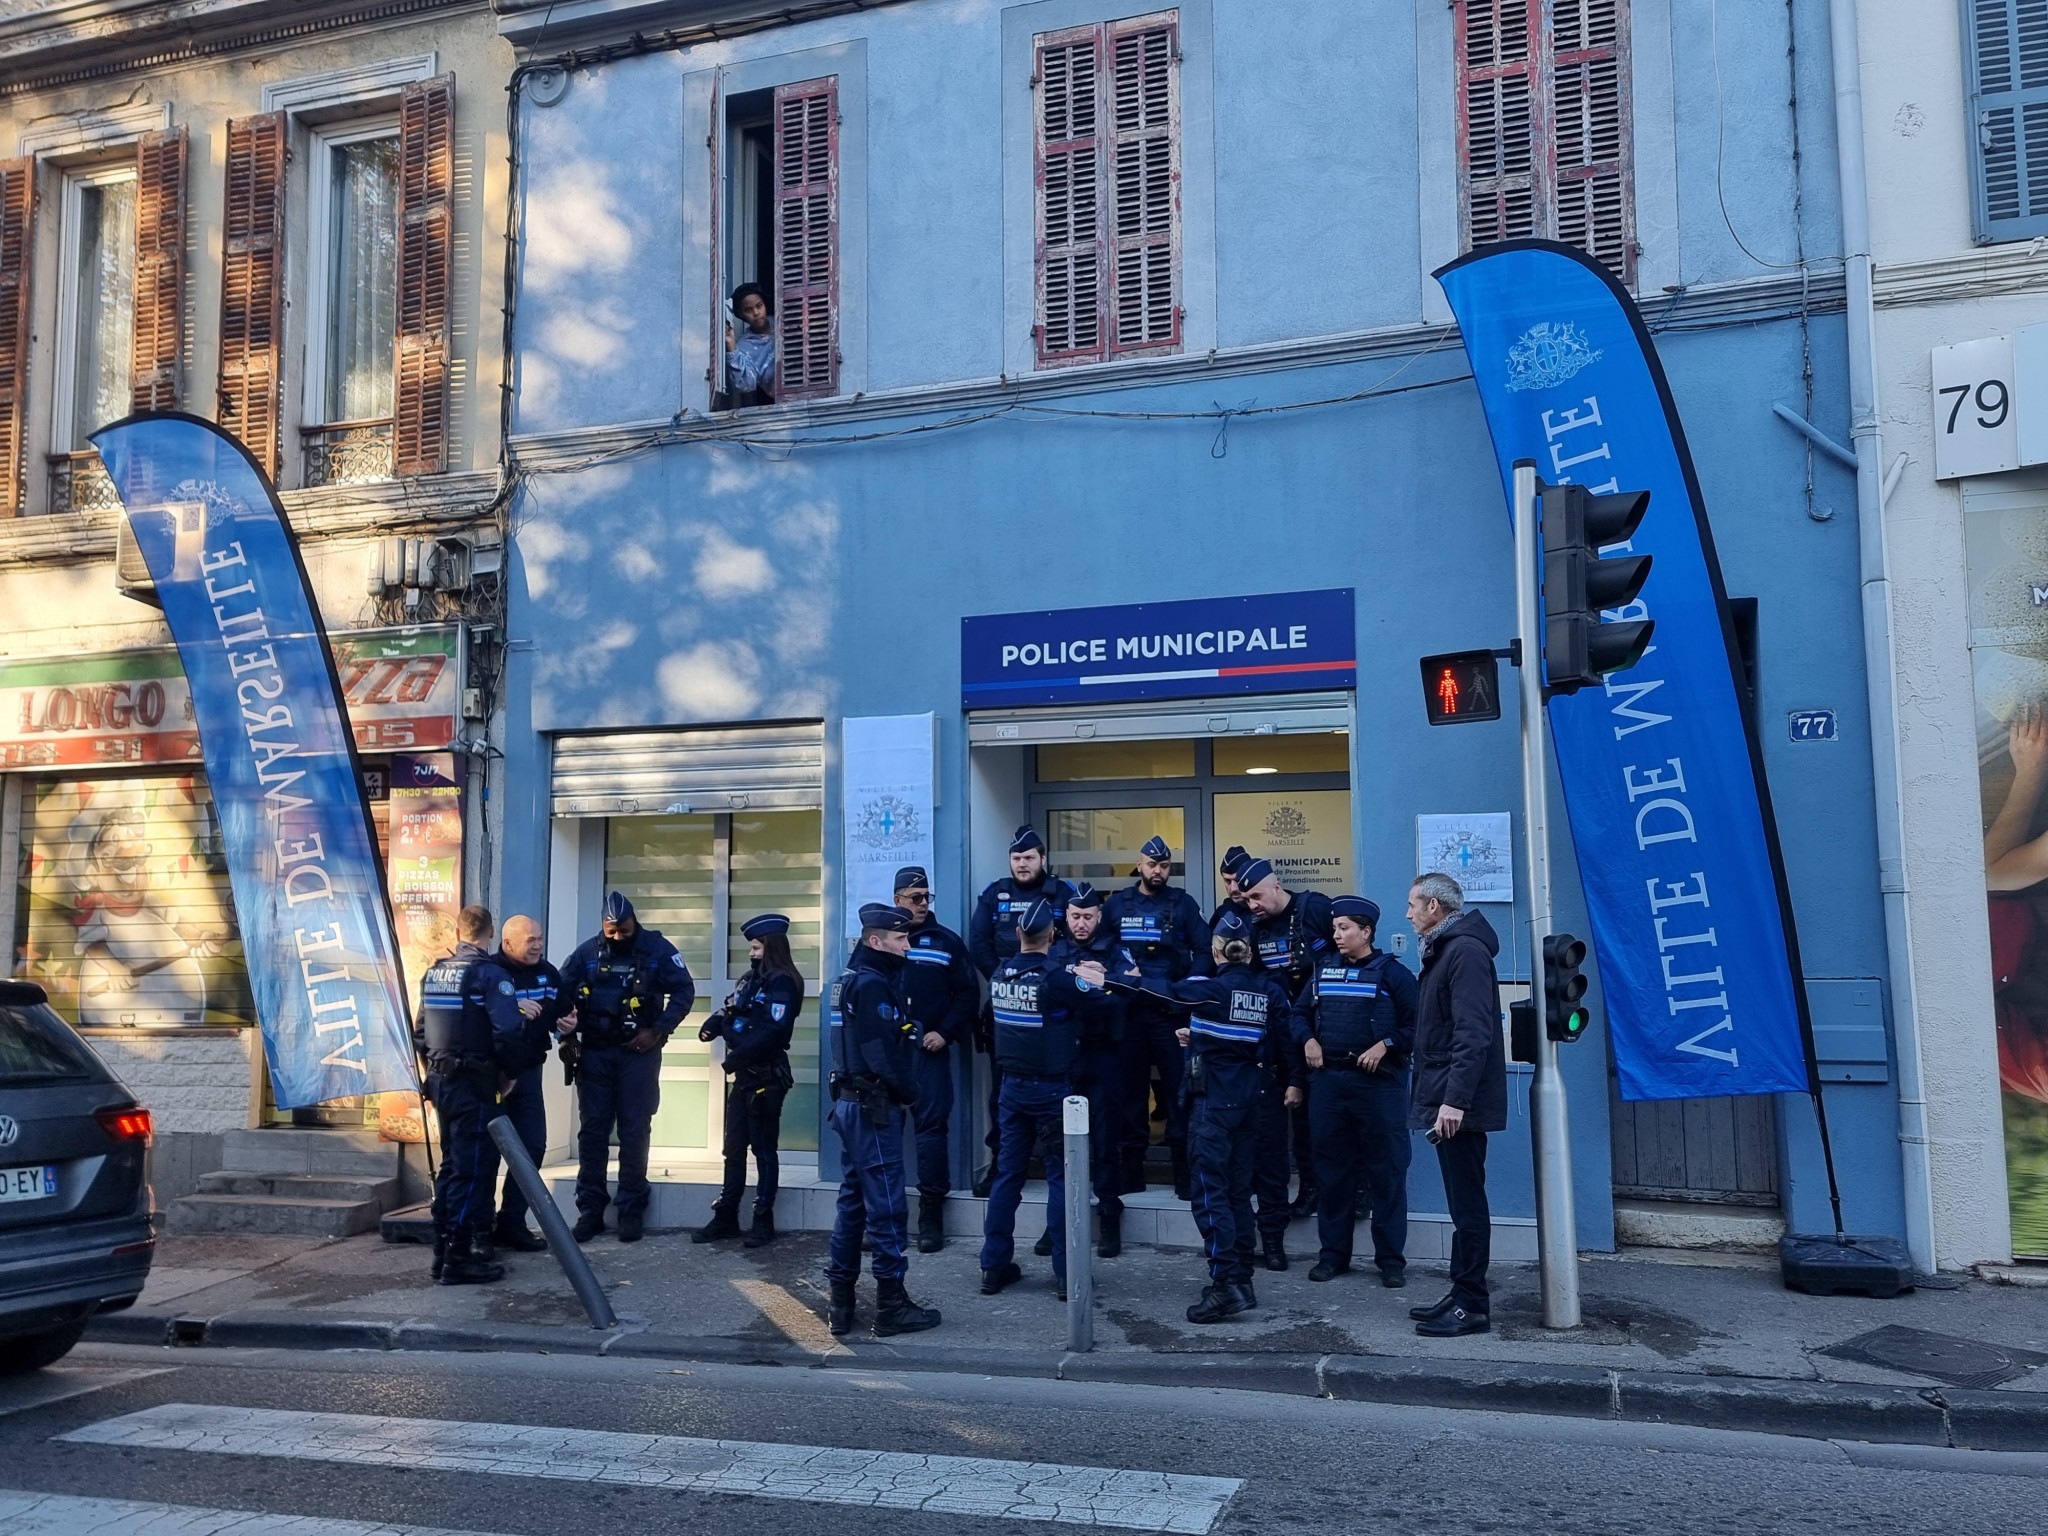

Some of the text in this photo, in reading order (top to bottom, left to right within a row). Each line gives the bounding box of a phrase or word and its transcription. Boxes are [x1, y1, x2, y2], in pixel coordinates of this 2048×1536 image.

[1938, 380, 2009, 434] 79
[1002, 625, 1308, 667] POLICE MUNICIPALE
[18, 681, 166, 734] LONGO
[1797, 717, 1827, 736] 77
[414, 765, 439, 776] 7J/7
[392, 788, 420, 798] 17H30
[432, 787, 461, 797] 22H00
[402, 813, 443, 824] PORTION
[418, 856, 429, 868] 3
[859, 851, 918, 863] MARSEILLE
[1275, 858, 1341, 866] MUNICIPALE
[398, 870, 440, 880] PIZZAS
[393, 881, 454, 892] 1 BOISSON
[1460, 881, 1496, 891] SEILLE
[393, 892, 445, 903] OFFERTE
[426, 969, 464, 983] POLICE
[424, 983, 460, 993] MUNICIPALE
[991, 982, 1037, 1001] POLICE
[992, 997, 1038, 1012] MUNICIPALE
[1234, 993, 1269, 1012] POLICE
[45, 1181, 55, 1193] 13
